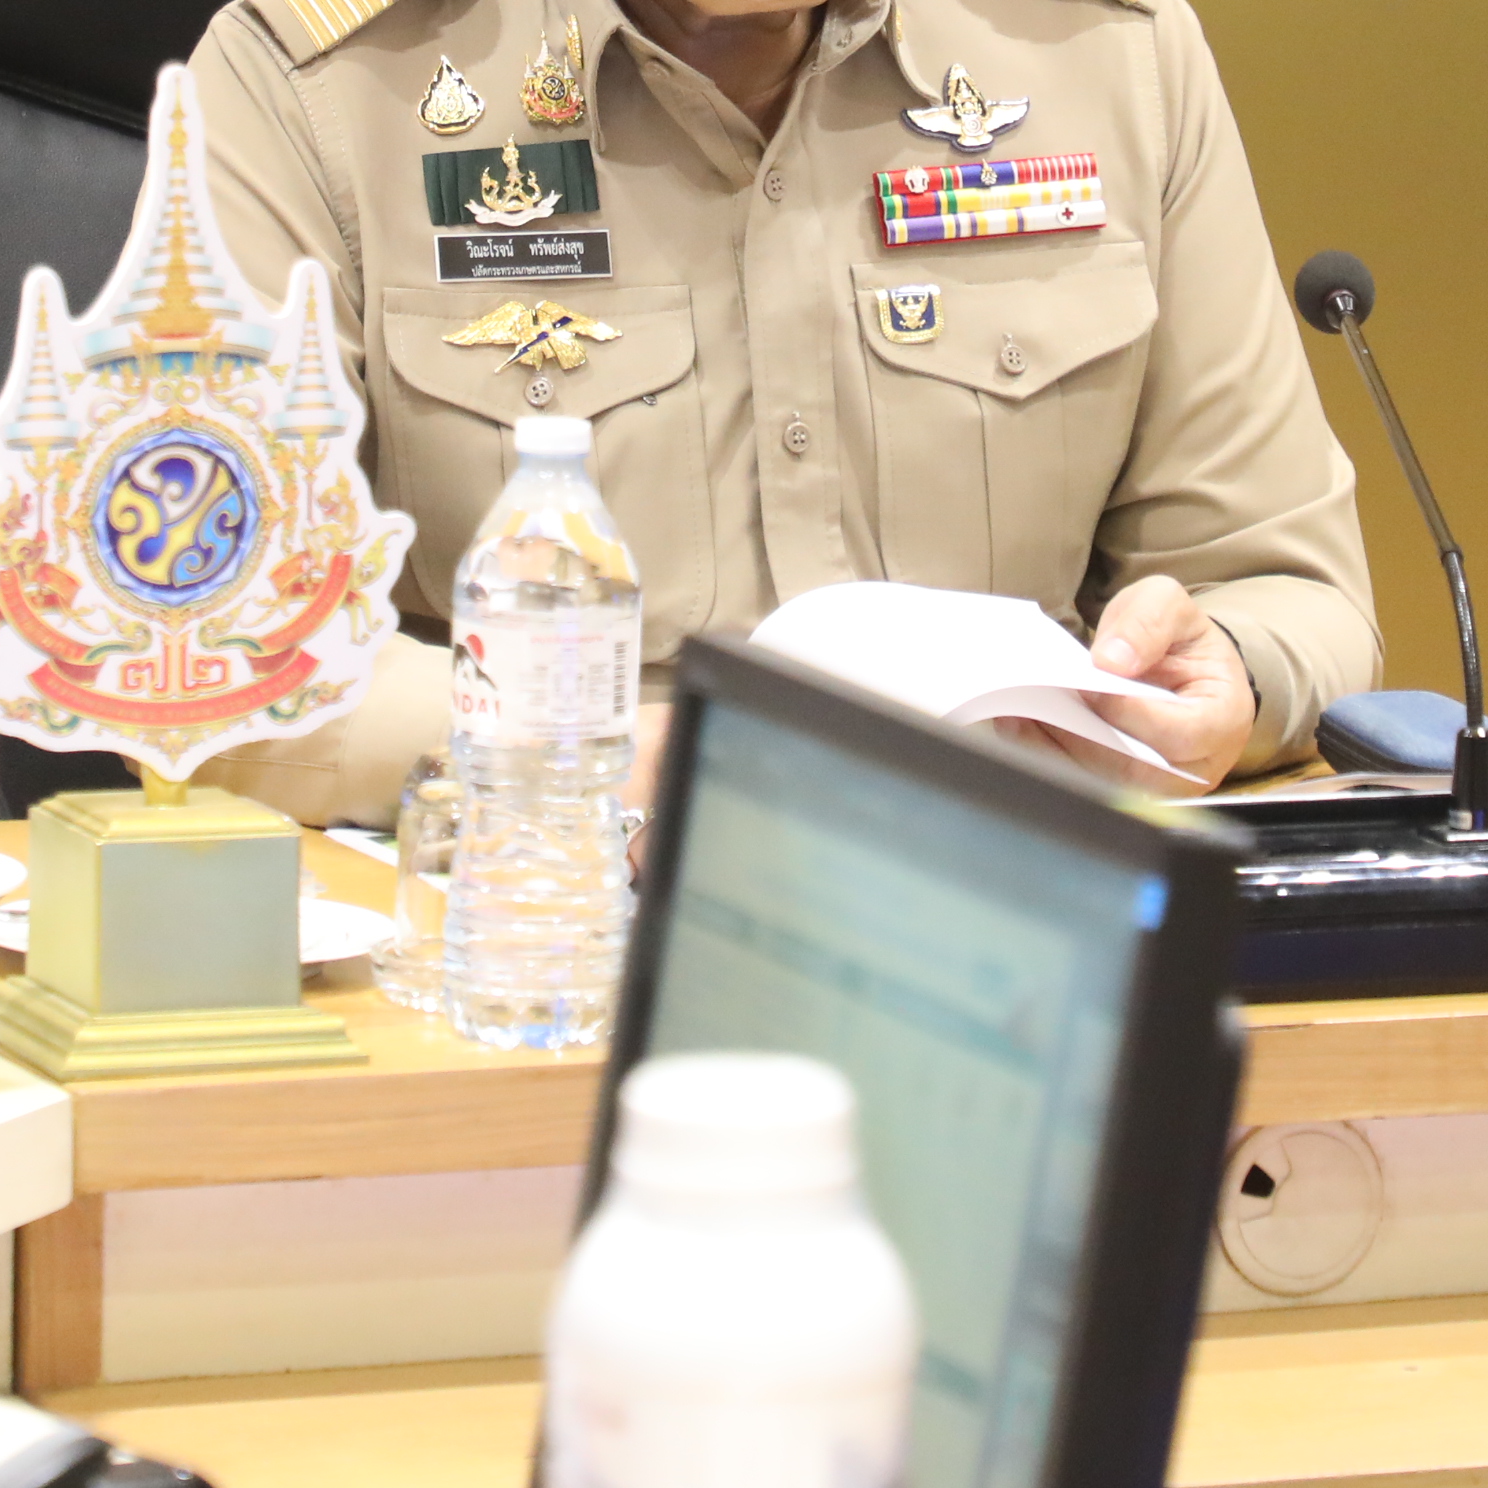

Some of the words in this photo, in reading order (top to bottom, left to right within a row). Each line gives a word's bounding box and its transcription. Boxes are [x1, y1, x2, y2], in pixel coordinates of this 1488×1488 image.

[465, 239, 515, 259] วิณะโรจน์
[528, 237, 585, 261] ทรัพย์ส่งสุข
